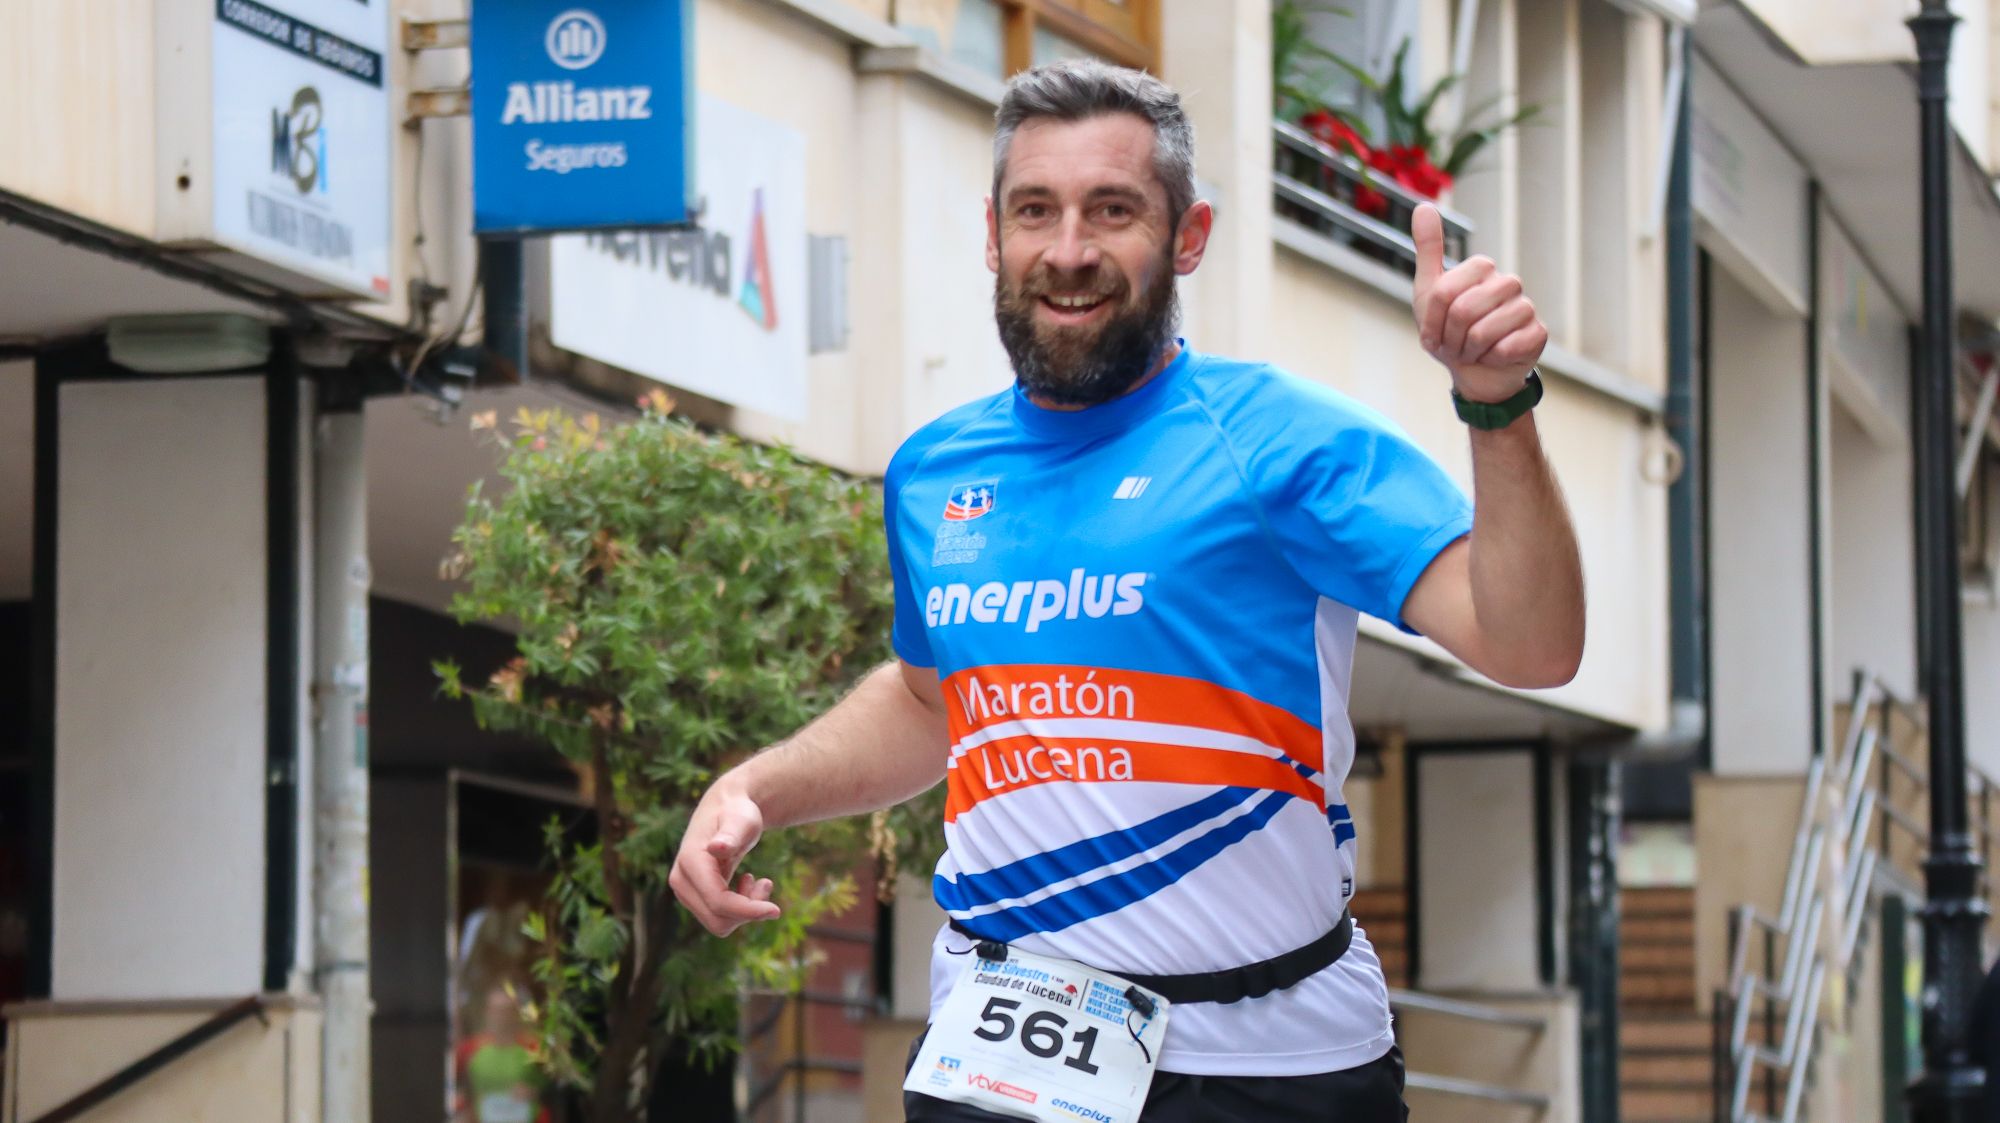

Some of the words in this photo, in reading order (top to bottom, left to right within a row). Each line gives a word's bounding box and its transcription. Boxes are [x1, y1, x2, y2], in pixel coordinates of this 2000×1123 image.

[222, 0, 292, 43] CORREDOR
[294, 25, 311, 52] DE
[502, 80, 653, 125] Allianz
[525, 139, 627, 174] Seguros
[925, 568, 1146, 633] enerplus
[954, 671, 1134, 725] Maratón
[981, 746, 1133, 790] Lucena
[974, 972, 1011, 988] Ciudad
[1010, 978, 1025, 990] de
[1025, 980, 1073, 1007] Lucena
[1001, 963, 1050, 984] Silvestre
[973, 996, 1099, 1076] 561
[1051, 1098, 1113, 1123] enerplus
